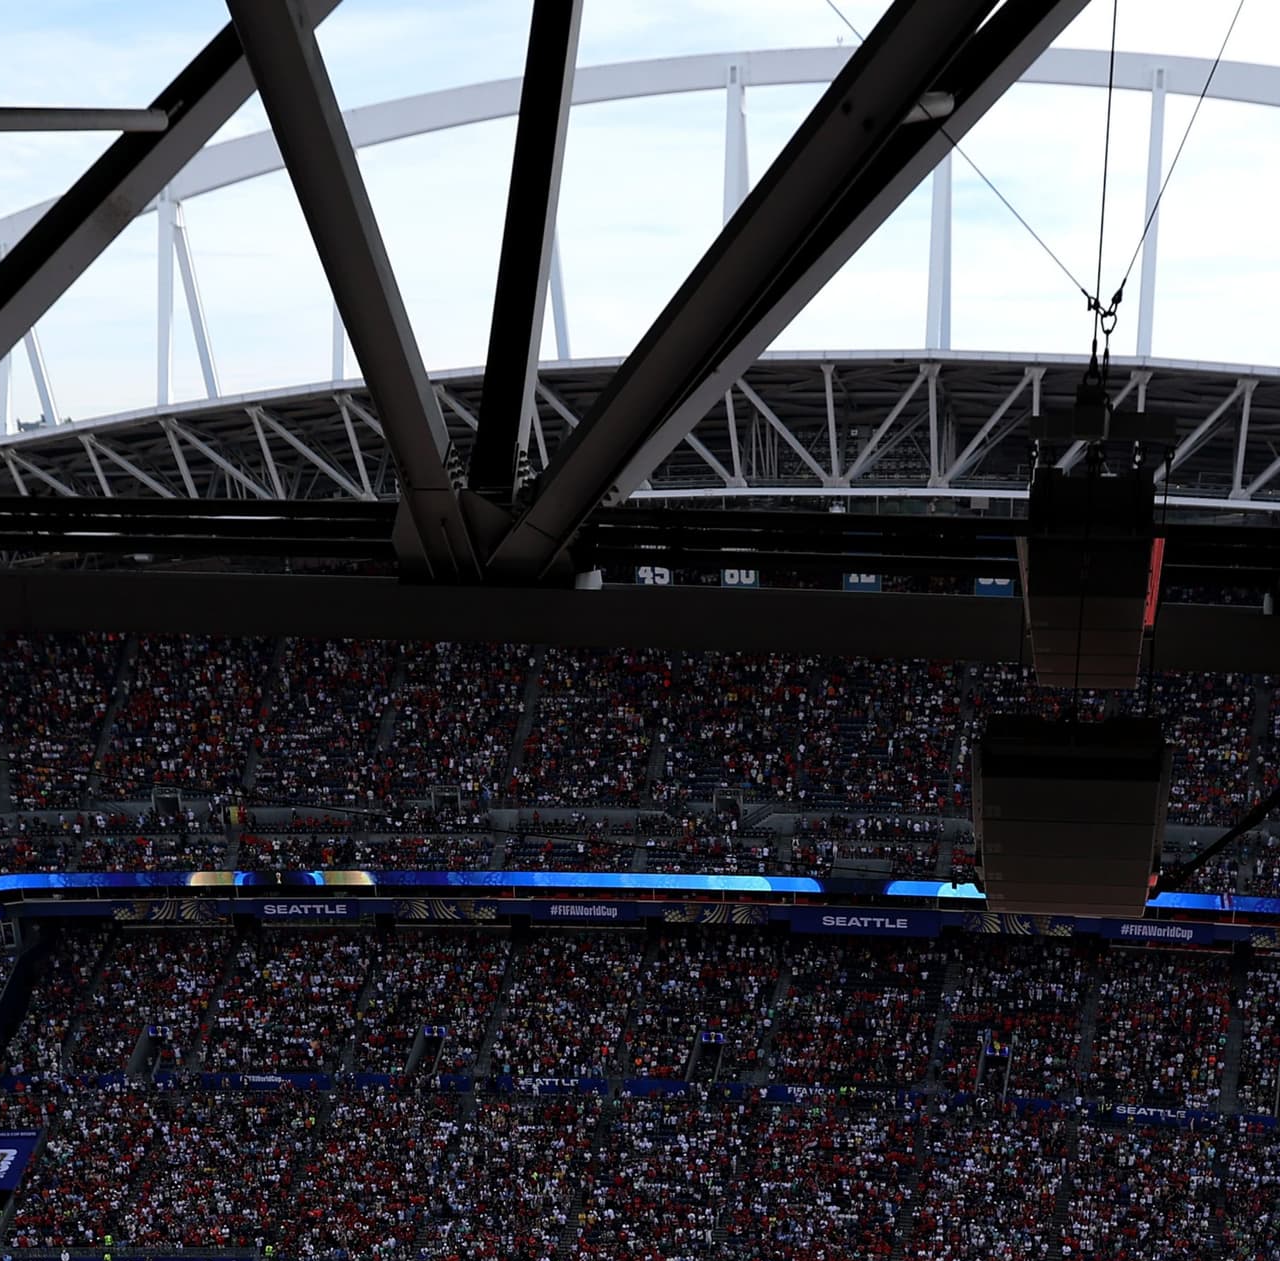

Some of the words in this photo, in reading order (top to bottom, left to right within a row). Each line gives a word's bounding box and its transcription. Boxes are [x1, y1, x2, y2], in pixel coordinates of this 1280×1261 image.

[263, 904, 348, 915] SEATTLE
[549, 904, 618, 919] #FIFAWorldCup
[821, 916, 909, 929] SEATTLE
[1120, 924, 1194, 941] #FIFAWorldCup
[1115, 1106, 1187, 1119] SEATTLE
